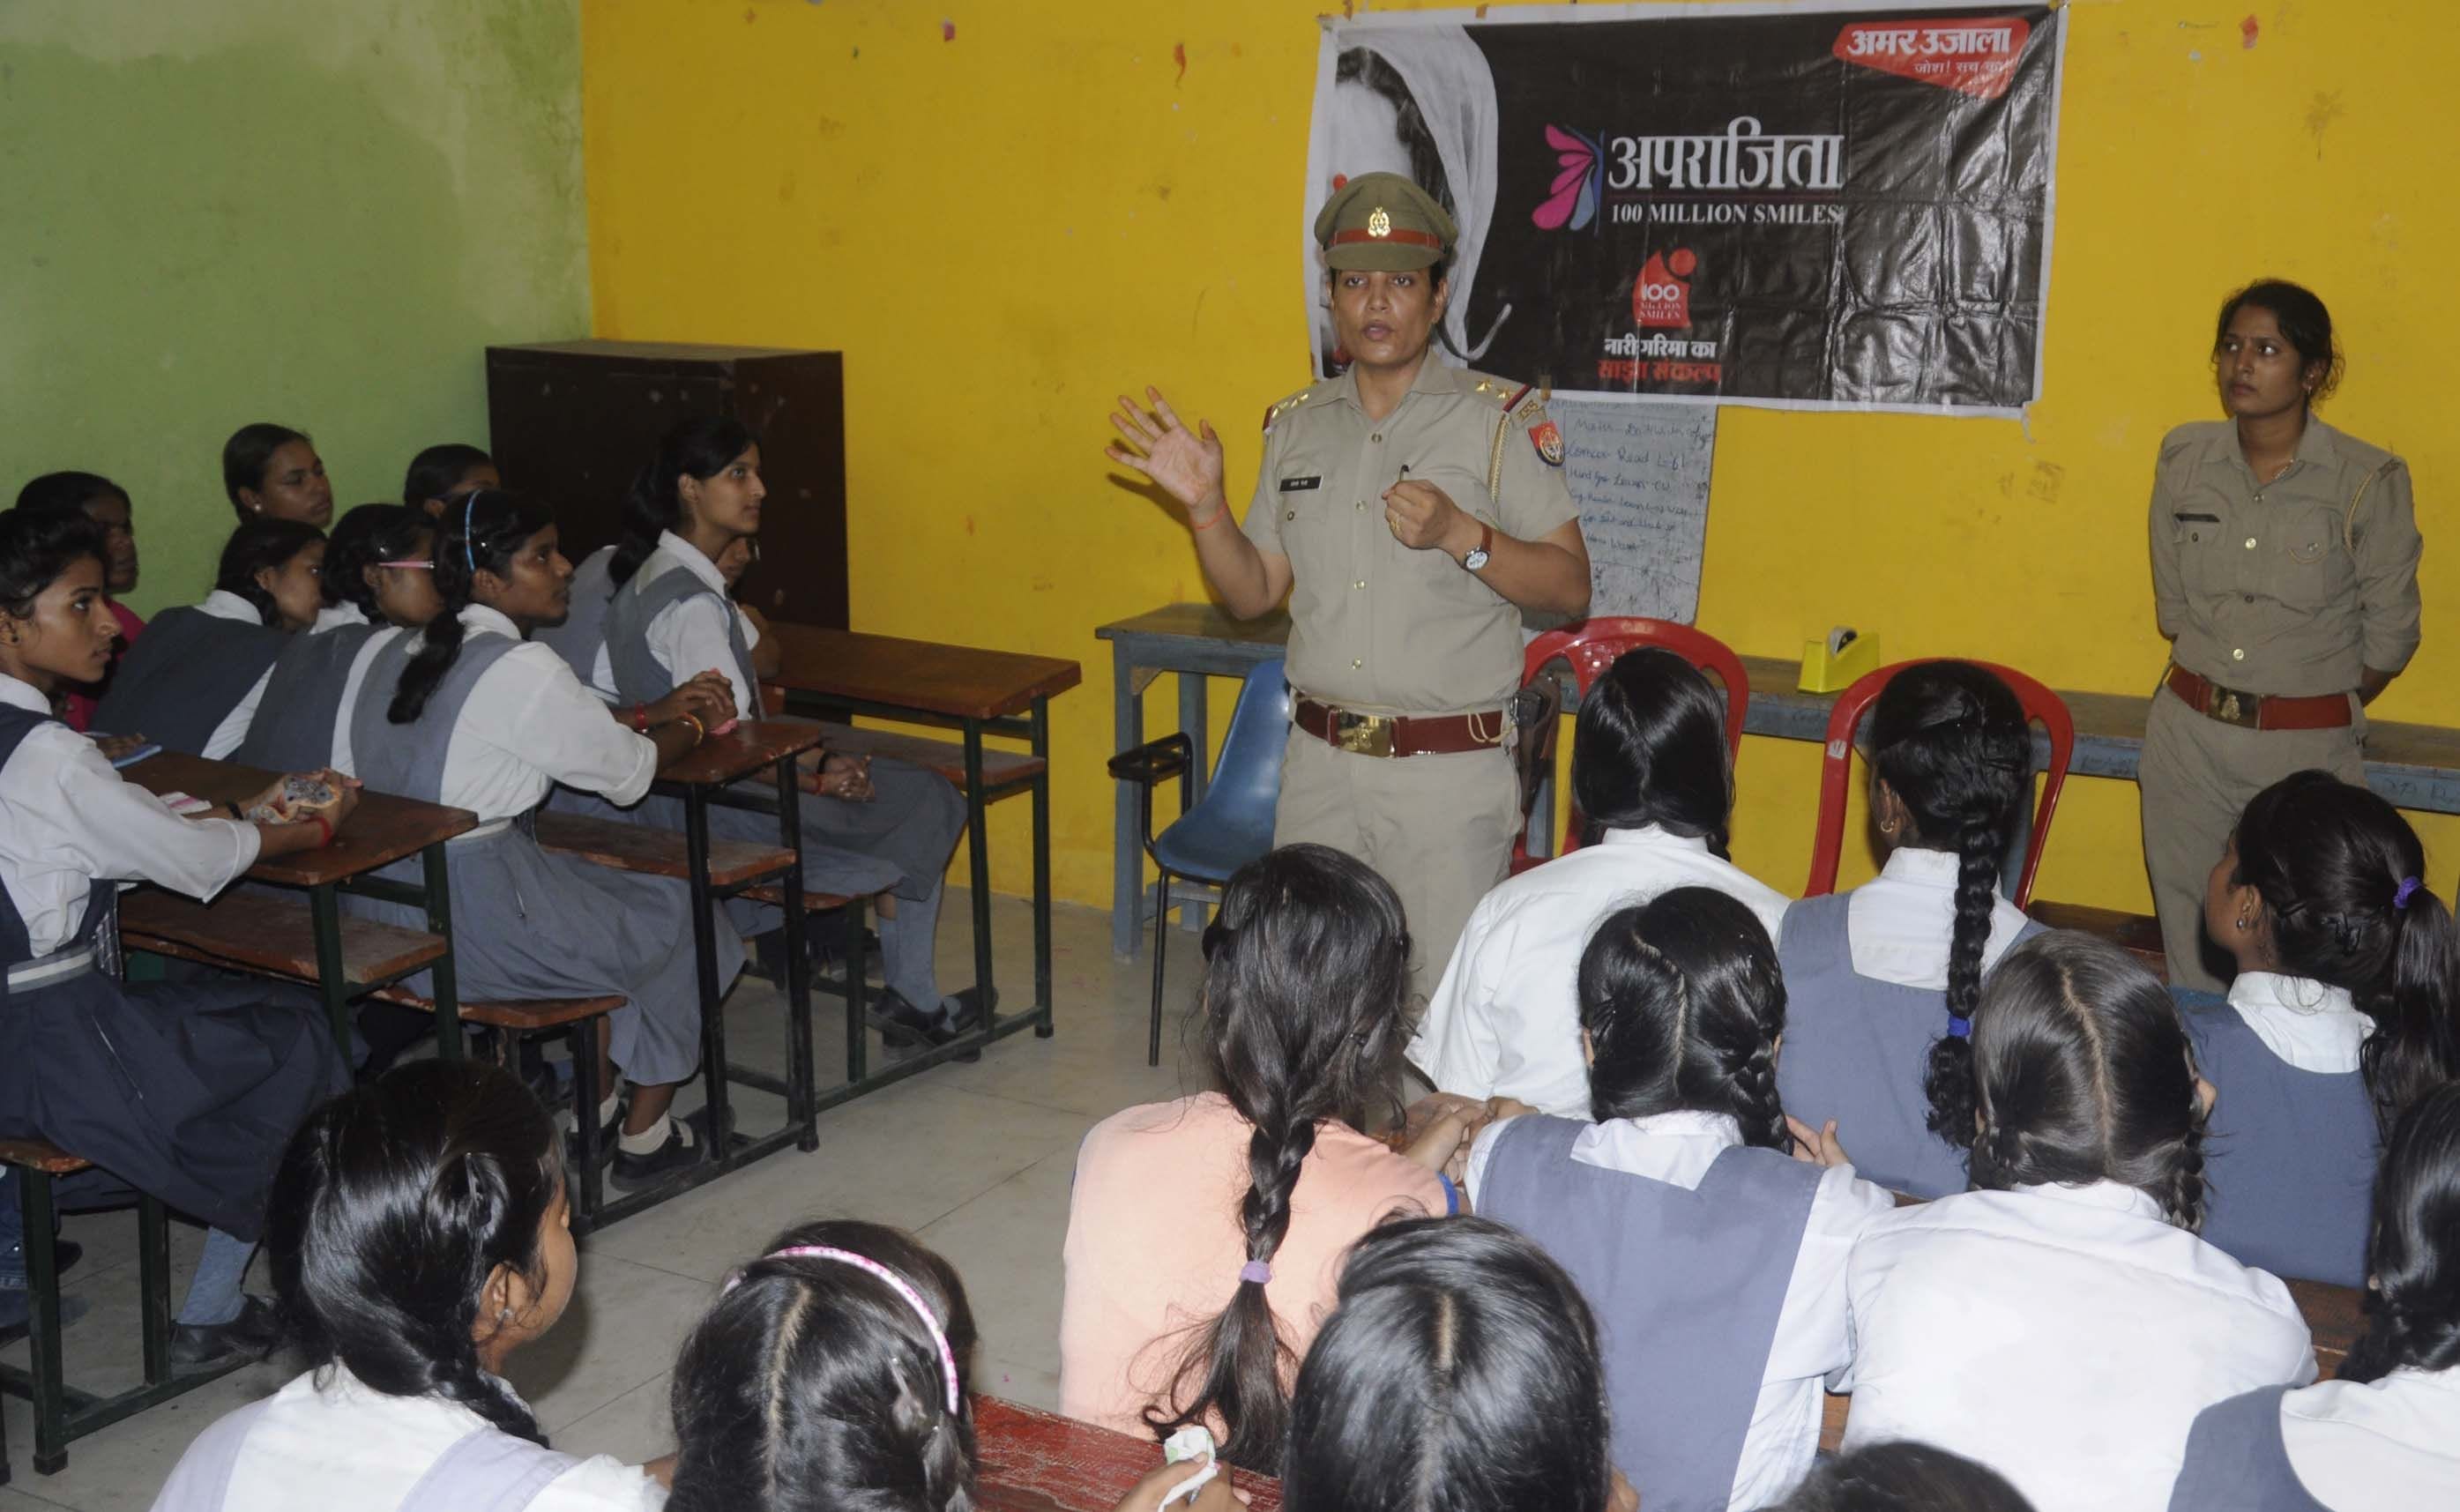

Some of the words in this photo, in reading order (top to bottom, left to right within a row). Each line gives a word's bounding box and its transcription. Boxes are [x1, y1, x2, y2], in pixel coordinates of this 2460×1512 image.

[1847, 29, 1918, 56] अमर
[1920, 27, 2011, 55] उजाला
[1608, 115, 1845, 190] अपराजिता
[1612, 204, 1643, 222] 100
[1649, 205, 1748, 222] MILLION
[1753, 205, 1841, 225] SMILES
[1643, 284, 1680, 302] 100
[1604, 332, 1637, 355] नारी
[1640, 333, 1688, 357] गरिमा
[1691, 341, 1717, 358] का
